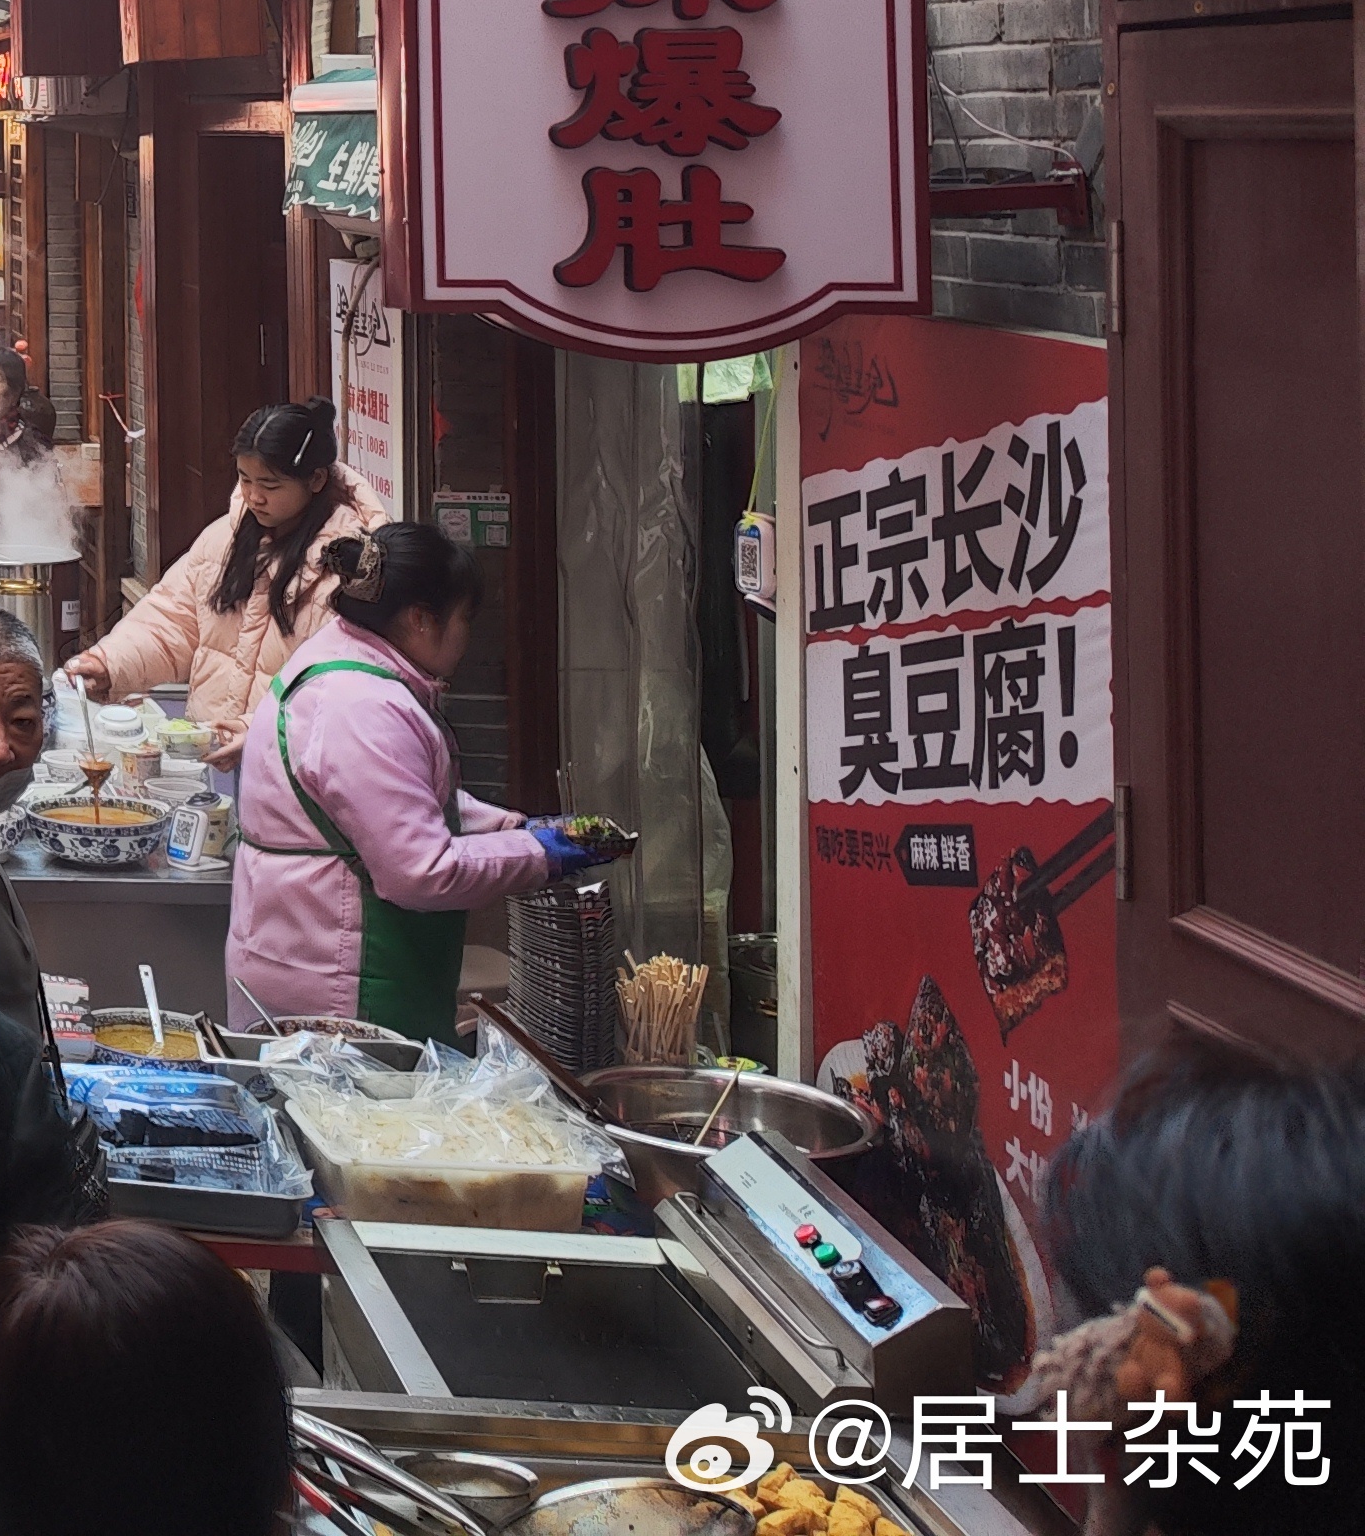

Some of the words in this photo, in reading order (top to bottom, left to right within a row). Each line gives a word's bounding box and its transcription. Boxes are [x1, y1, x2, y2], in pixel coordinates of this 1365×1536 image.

[807, 419, 1088, 633] 正宗长沙
[838, 616, 1080, 800] 臭豆腐!
[815, 824, 893, 874] 嗨吃要尽兴
[1004, 1058, 1053, 1136] 小份
